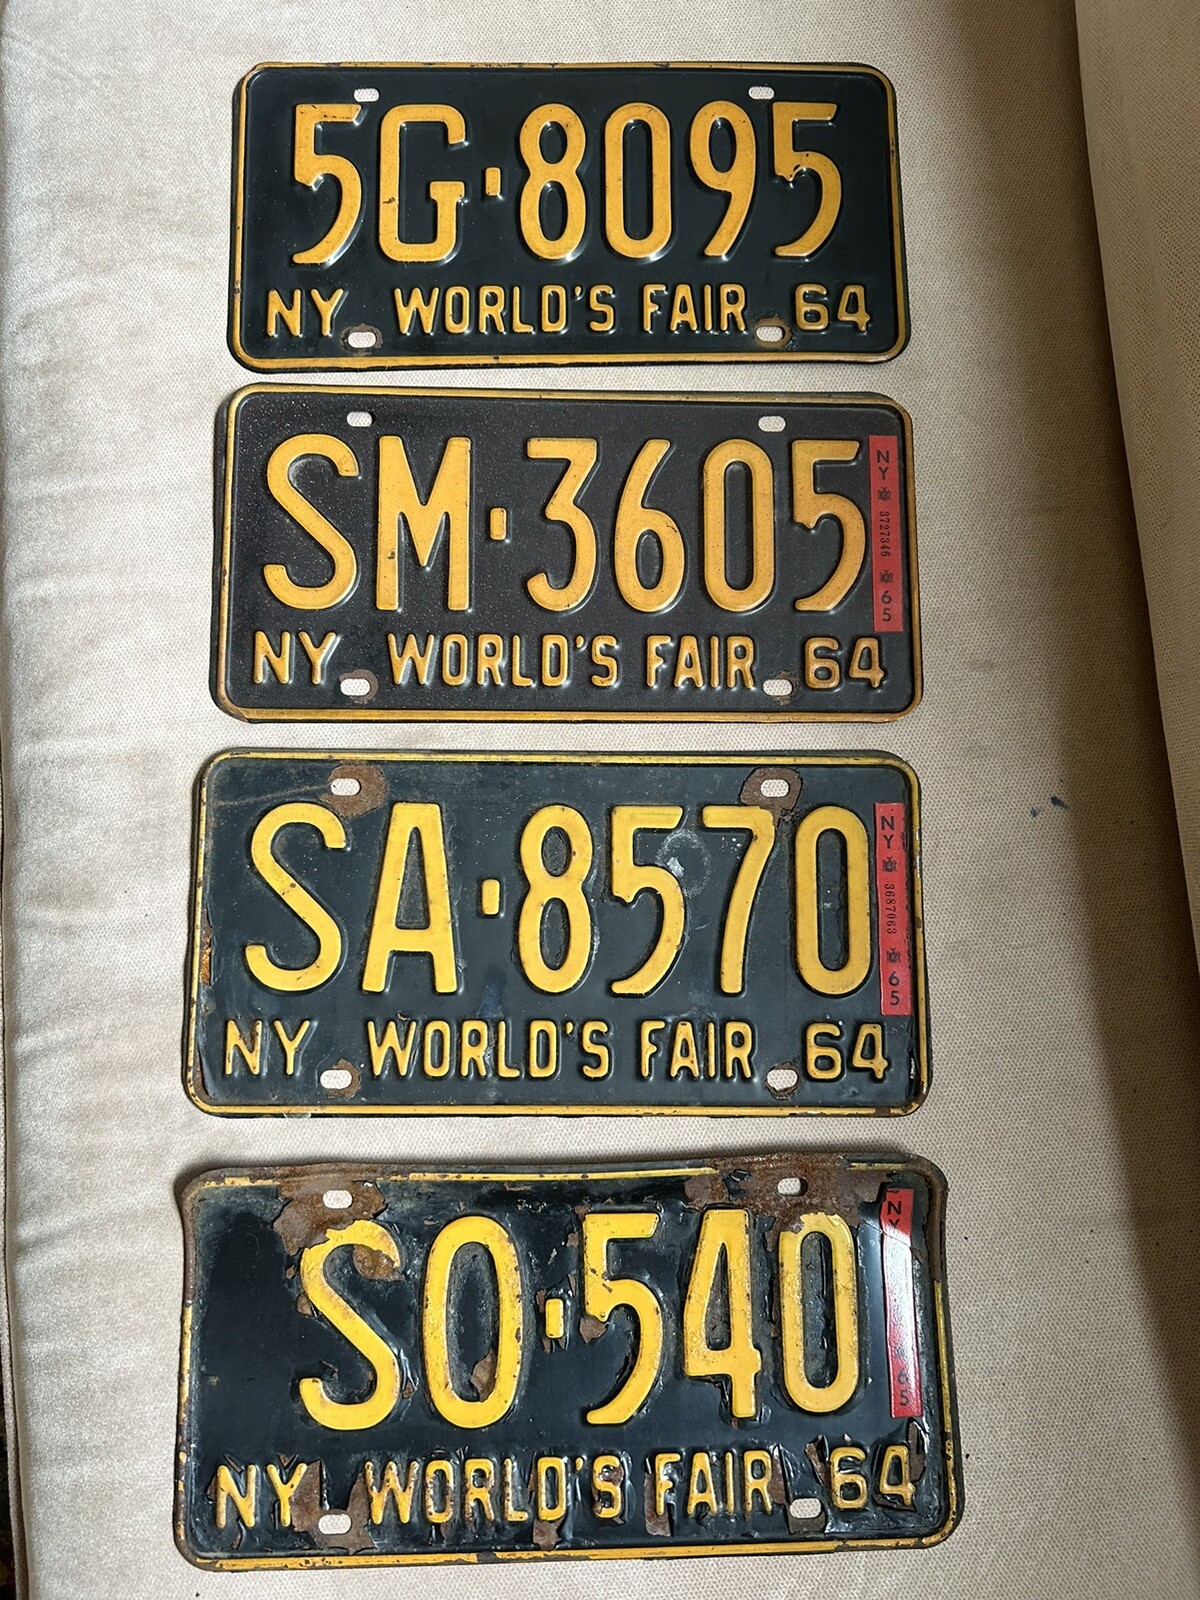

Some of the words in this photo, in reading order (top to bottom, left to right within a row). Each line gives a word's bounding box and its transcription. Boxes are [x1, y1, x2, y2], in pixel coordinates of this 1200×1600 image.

[266, 288, 345, 337] NY
[394, 285, 615, 335] WORLD'S
[642, 284, 747, 333] FAIR
[795, 284, 871, 332] 64
[876, 450, 890, 480] NY
[881, 590, 893, 622] 65
[253, 631, 337, 685] NY
[388, 633, 618, 688] WORLD'S
[646, 634, 756, 690] FAIR
[804, 637, 887, 689] 64
[881, 815, 895, 849] NY
[884, 883, 897, 935] 3687063
[888, 970, 901, 1006] 65
[225, 1020, 310, 1077] NY
[366, 1019, 611, 1079] WORLD'S
[641, 1020, 754, 1080] FAIR
[805, 1022, 890, 1082] 64
[216, 1463, 307, 1528] NY
[363, 1452, 623, 1525] WORLD'S
[654, 1449, 774, 1518] FAIR
[829, 1446, 916, 1510] 64
